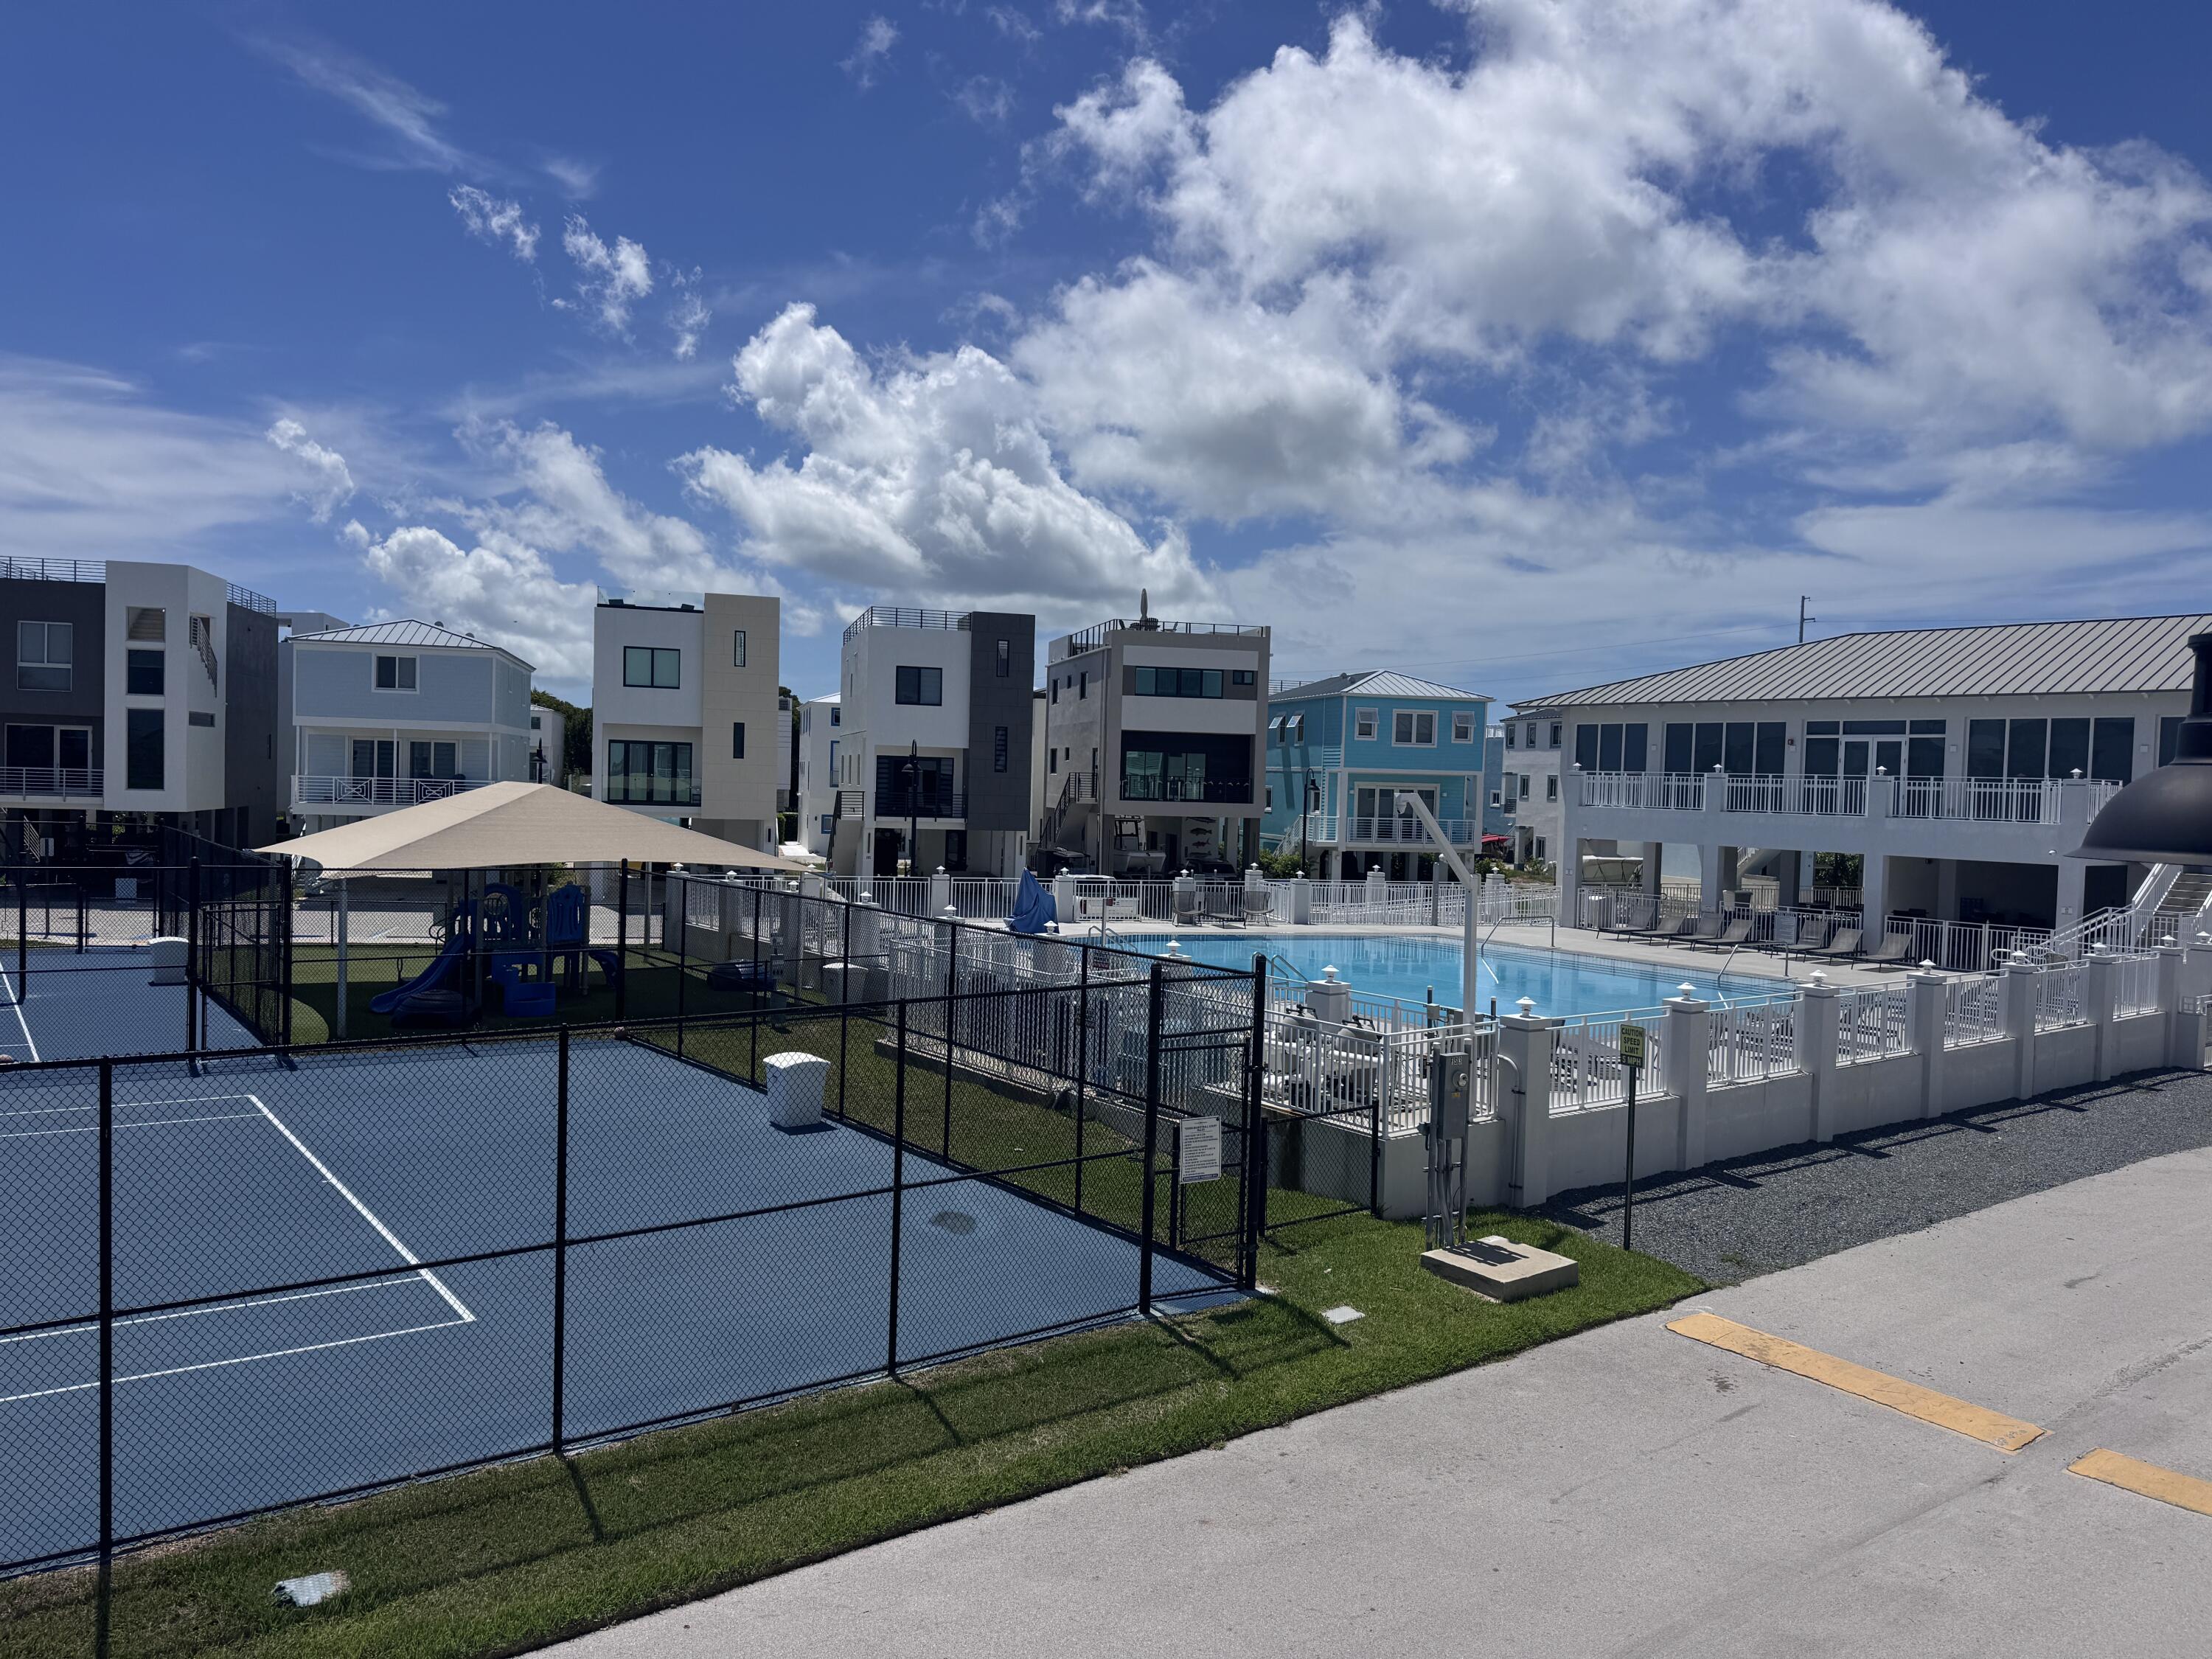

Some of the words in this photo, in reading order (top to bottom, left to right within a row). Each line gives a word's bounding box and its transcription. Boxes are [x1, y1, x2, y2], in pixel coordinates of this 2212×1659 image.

[1622, 1028, 1644, 1037] CAUTION
[1624, 1037, 1641, 1046] SPEED
[1624, 1046, 1639, 1054] LIMIT
[1622, 1055, 1626, 1063] 5
[1628, 1057, 1641, 1066] MPH
